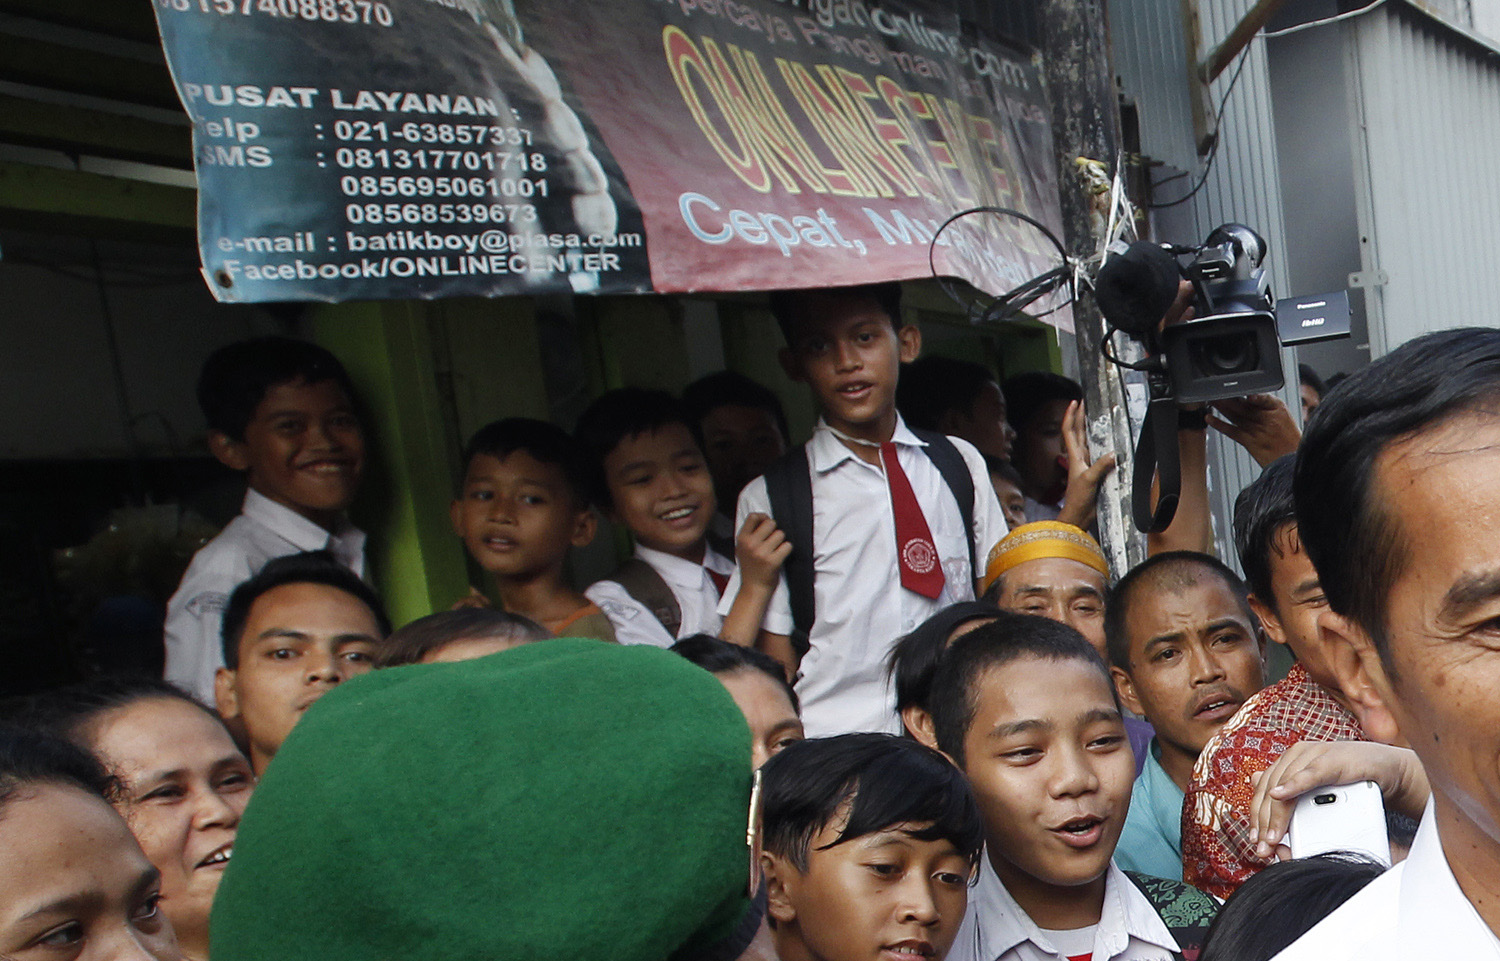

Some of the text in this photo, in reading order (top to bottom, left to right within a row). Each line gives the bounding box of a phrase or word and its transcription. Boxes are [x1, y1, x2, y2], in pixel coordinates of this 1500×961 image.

[182, 83, 319, 108] PUSAT
[330, 89, 499, 117] LAYANAN
[203, 145, 273, 167] SMS
[336, 148, 548, 172] 081317701718
[341, 175, 548, 197] 085695061001
[346, 203, 538, 224] 08568539673
[678, 192, 868, 257] Cepat,
[217, 232, 315, 253] e-mail
[347, 230, 641, 254] batikboy@plasa.com
[225, 253, 621, 280] Facebook/ONLINECENTER
